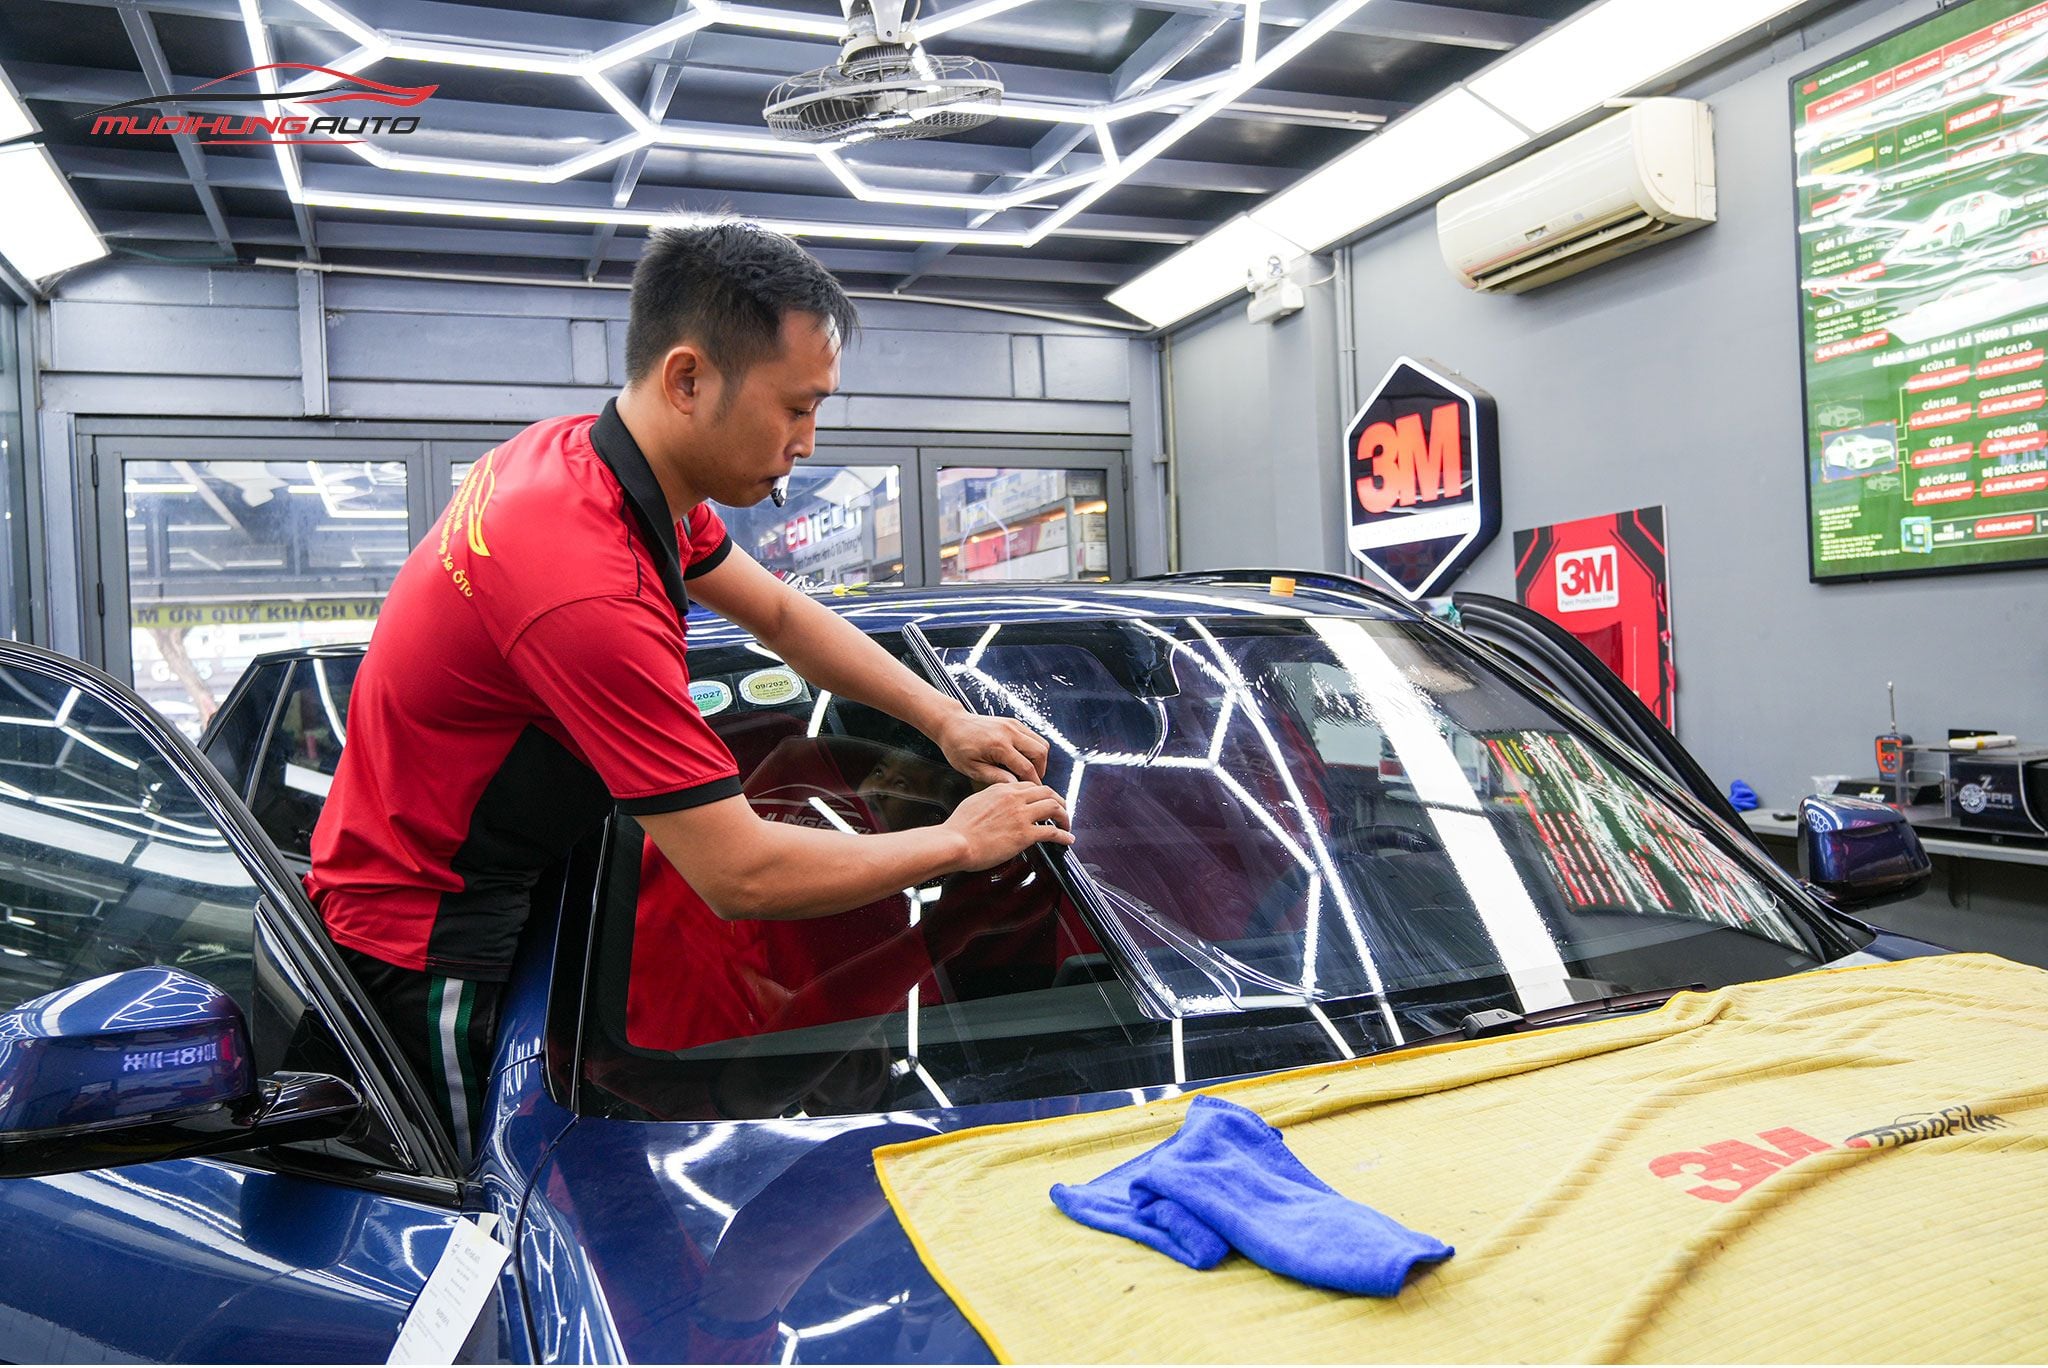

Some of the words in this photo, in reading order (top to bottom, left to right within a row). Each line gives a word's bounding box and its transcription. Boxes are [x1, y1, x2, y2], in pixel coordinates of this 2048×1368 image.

[1873, 350, 1904, 367] BẢNG
[1906, 343, 1929, 360] GIÁ
[1931, 339, 1956, 356] BÁN
[1958, 332, 1972, 348] LẺ
[1974, 326, 2009, 344] TỪNG
[2006, 344, 2019, 356] CA
[1926, 358, 1944, 372] CỬA
[1945, 358, 1956, 369] XE
[1941, 396, 1957, 407] SAU
[1946, 435, 1953, 445] B
[1356, 401, 1463, 514] 3M
[1950, 472, 1967, 483] SAU
[1561, 553, 1614, 597] 3M
[267, 602, 346, 620] KHÁCH
[755, 680, 789, 690] 09/2025
[690, 690, 721, 701] /2027
